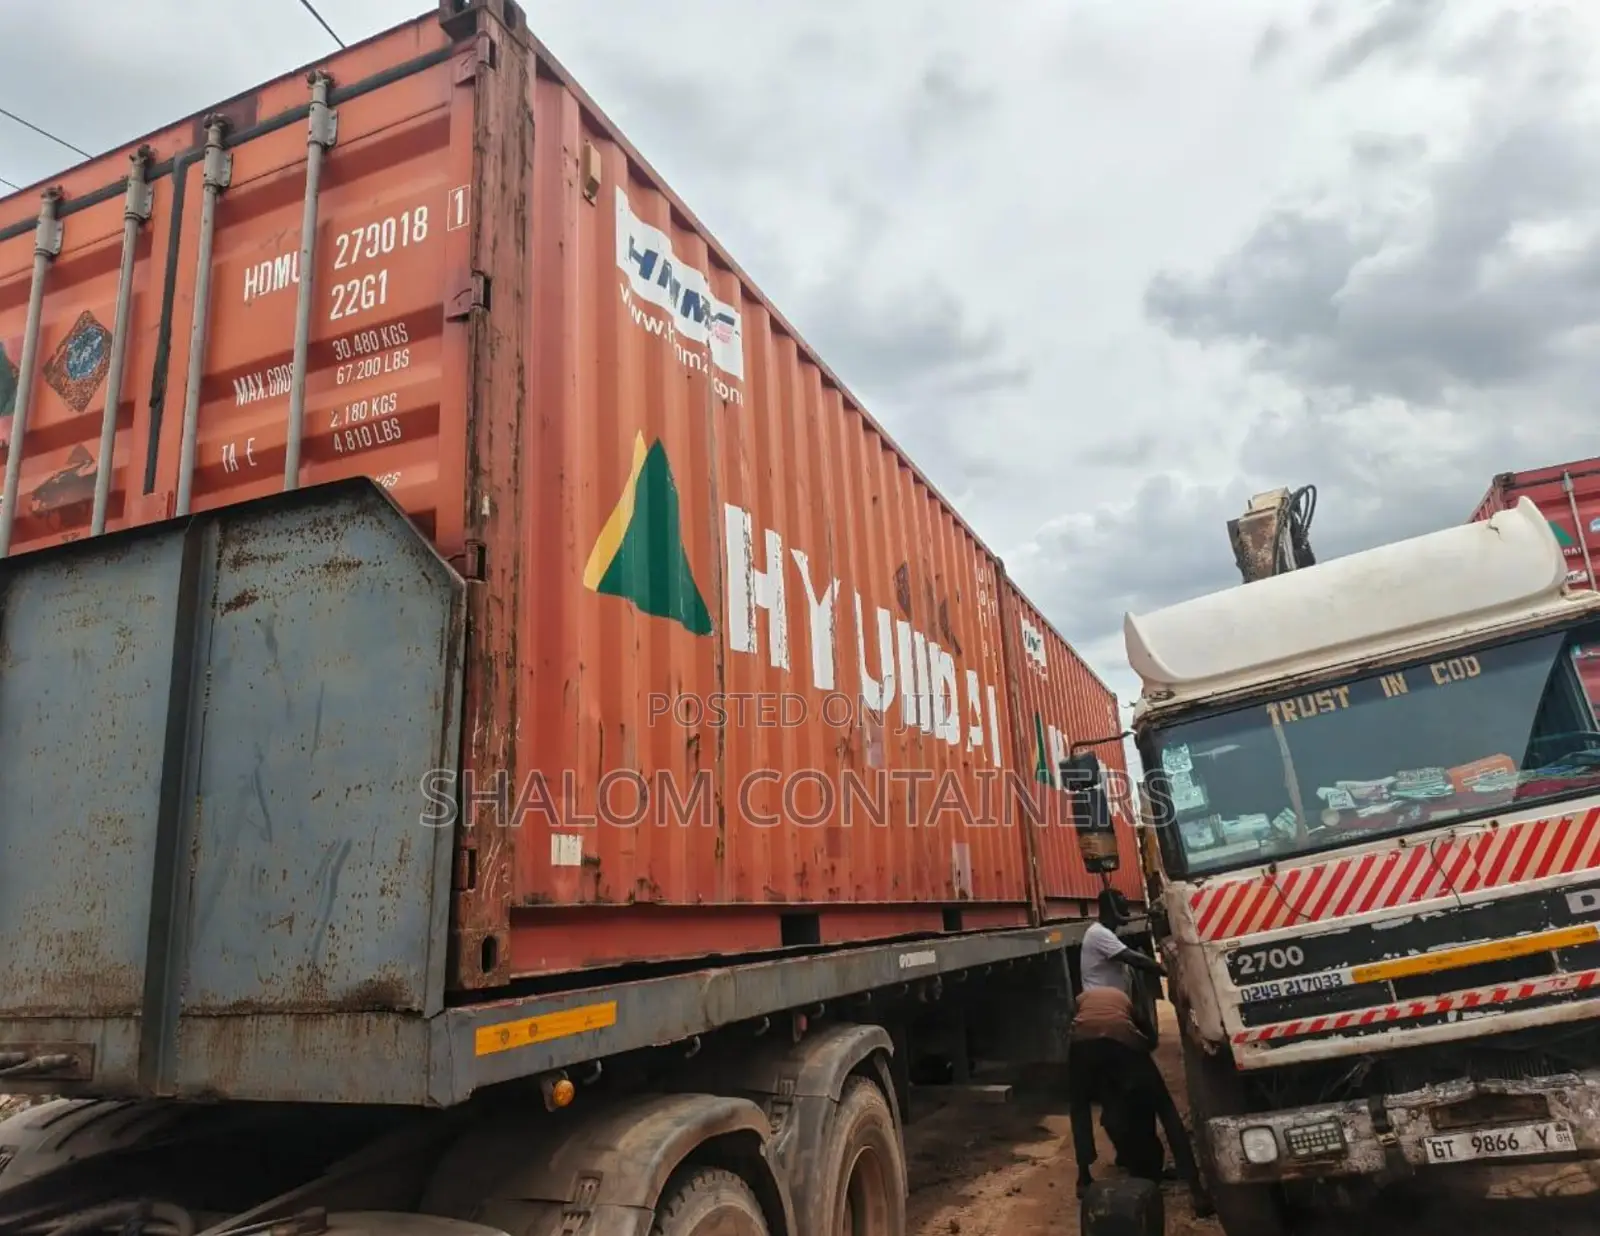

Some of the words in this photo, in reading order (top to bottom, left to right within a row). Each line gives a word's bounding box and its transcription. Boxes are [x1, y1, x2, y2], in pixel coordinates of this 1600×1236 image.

[453, 190, 463, 224] 1
[330, 269, 388, 320] 22G1
[332, 330, 380, 361] 30.480
[380, 322, 409, 348] KGS
[336, 356, 381, 385] 67.200
[383, 348, 410, 373] LBS
[371, 392, 398, 417] KGS
[221, 437, 258, 474] TAE
[334, 426, 373, 453] 4.810
[372, 417, 402, 444] LBS
[1266, 685, 1349, 725] TRUST
[1379, 671, 1409, 698] IN
[1237, 945, 1305, 975] 2700
[1431, 1138, 1456, 1158] GT
[1470, 1132, 1520, 1153] 9866
[1535, 1126, 1548, 1148] Y
